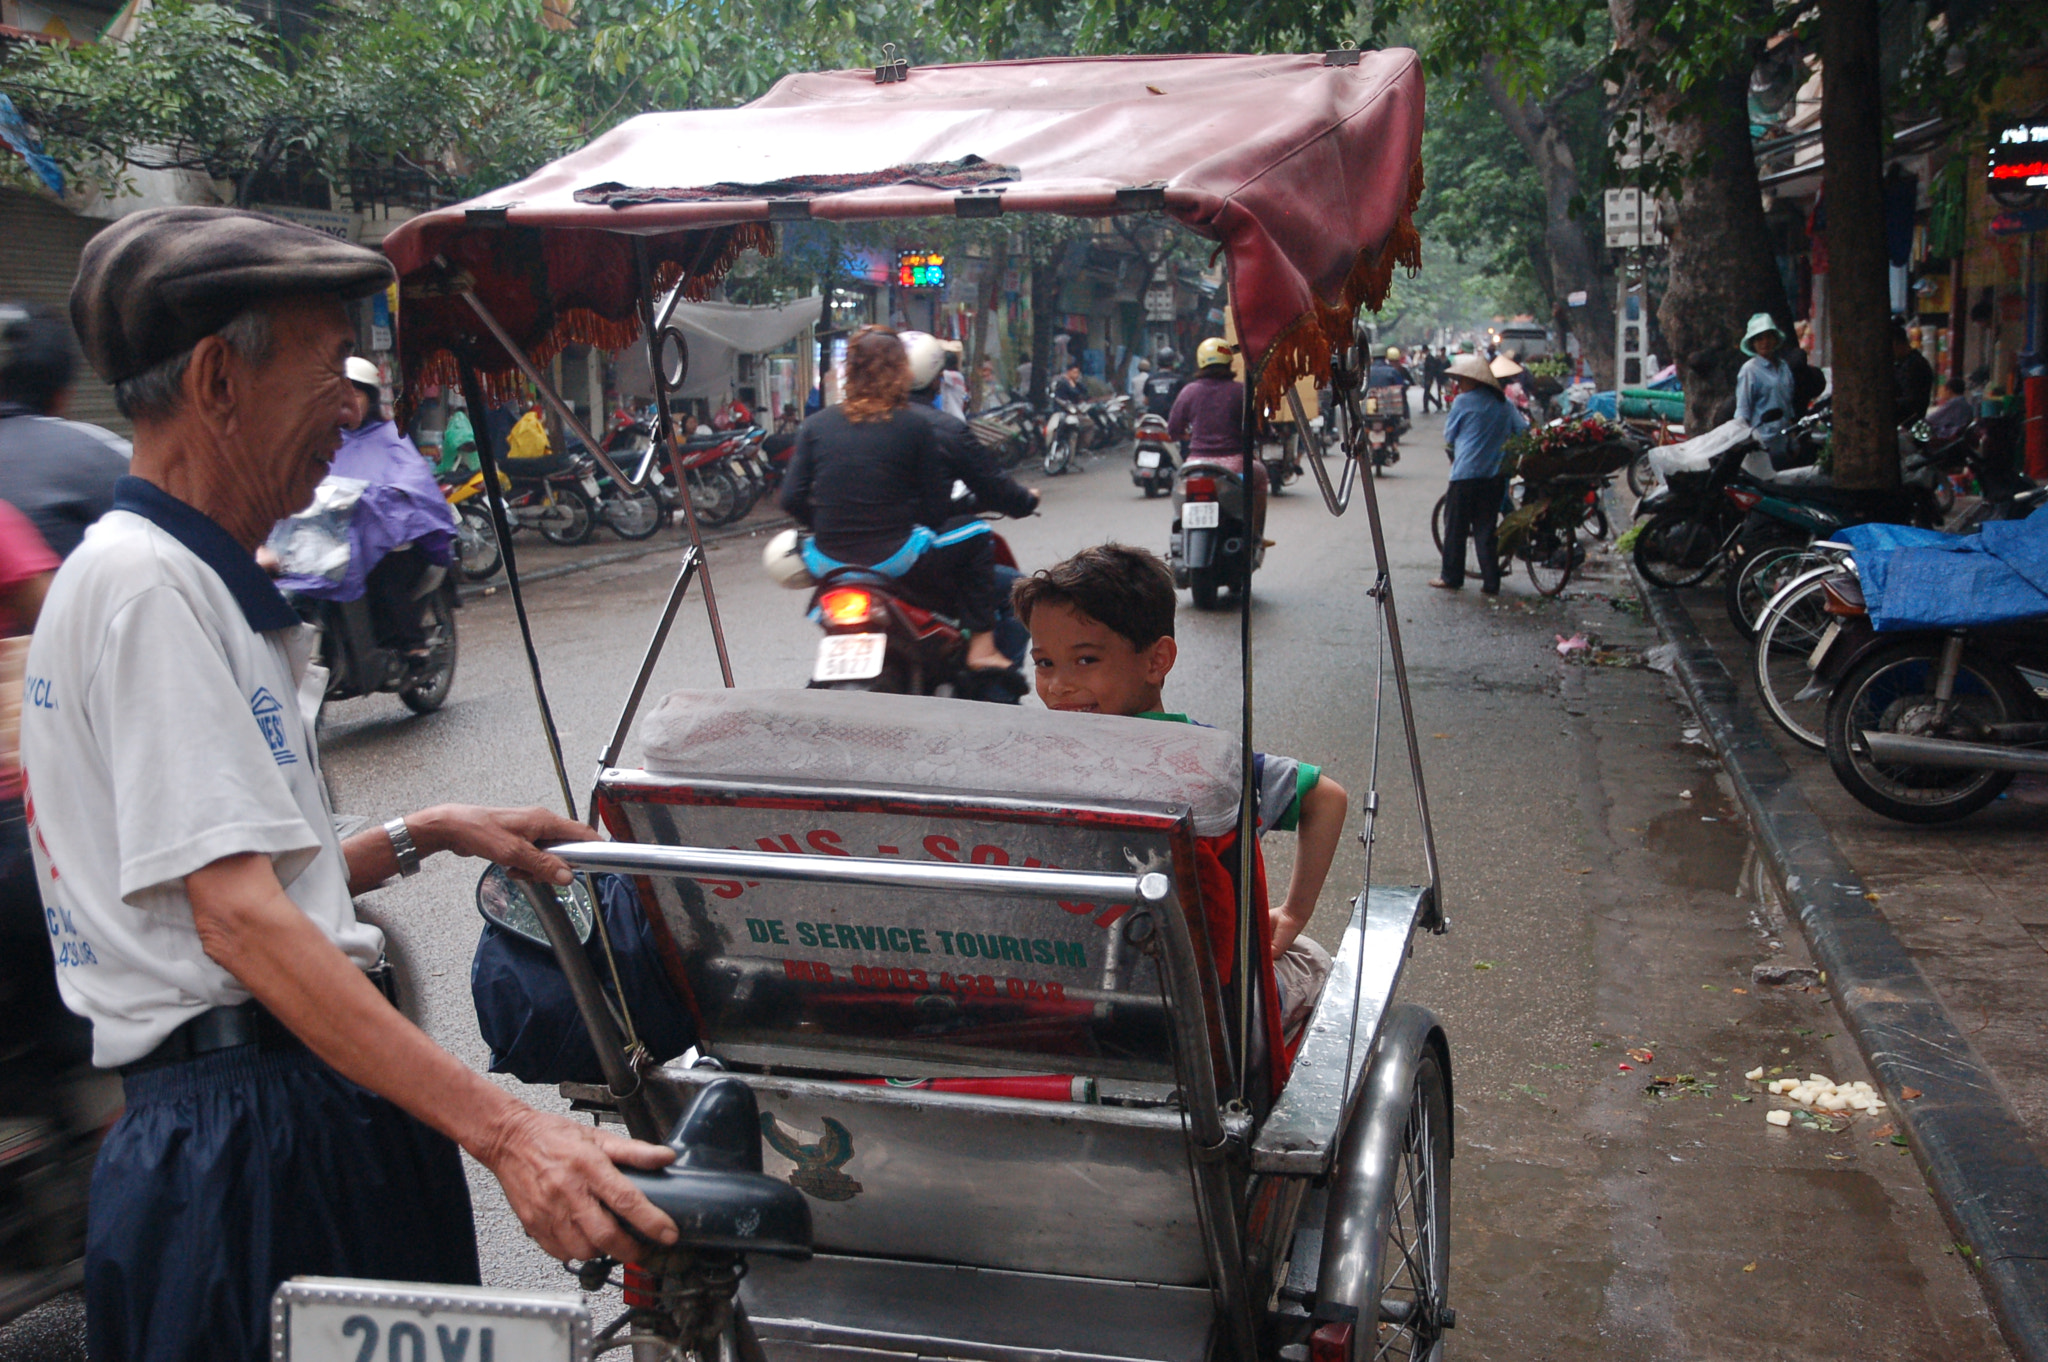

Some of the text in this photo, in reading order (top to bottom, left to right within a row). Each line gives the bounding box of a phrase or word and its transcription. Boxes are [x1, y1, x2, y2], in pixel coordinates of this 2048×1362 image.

[745, 917, 1088, 968] DE SERVICE TOURISM
[940, 971, 998, 997] 438
[1006, 977, 1067, 1003] 048
